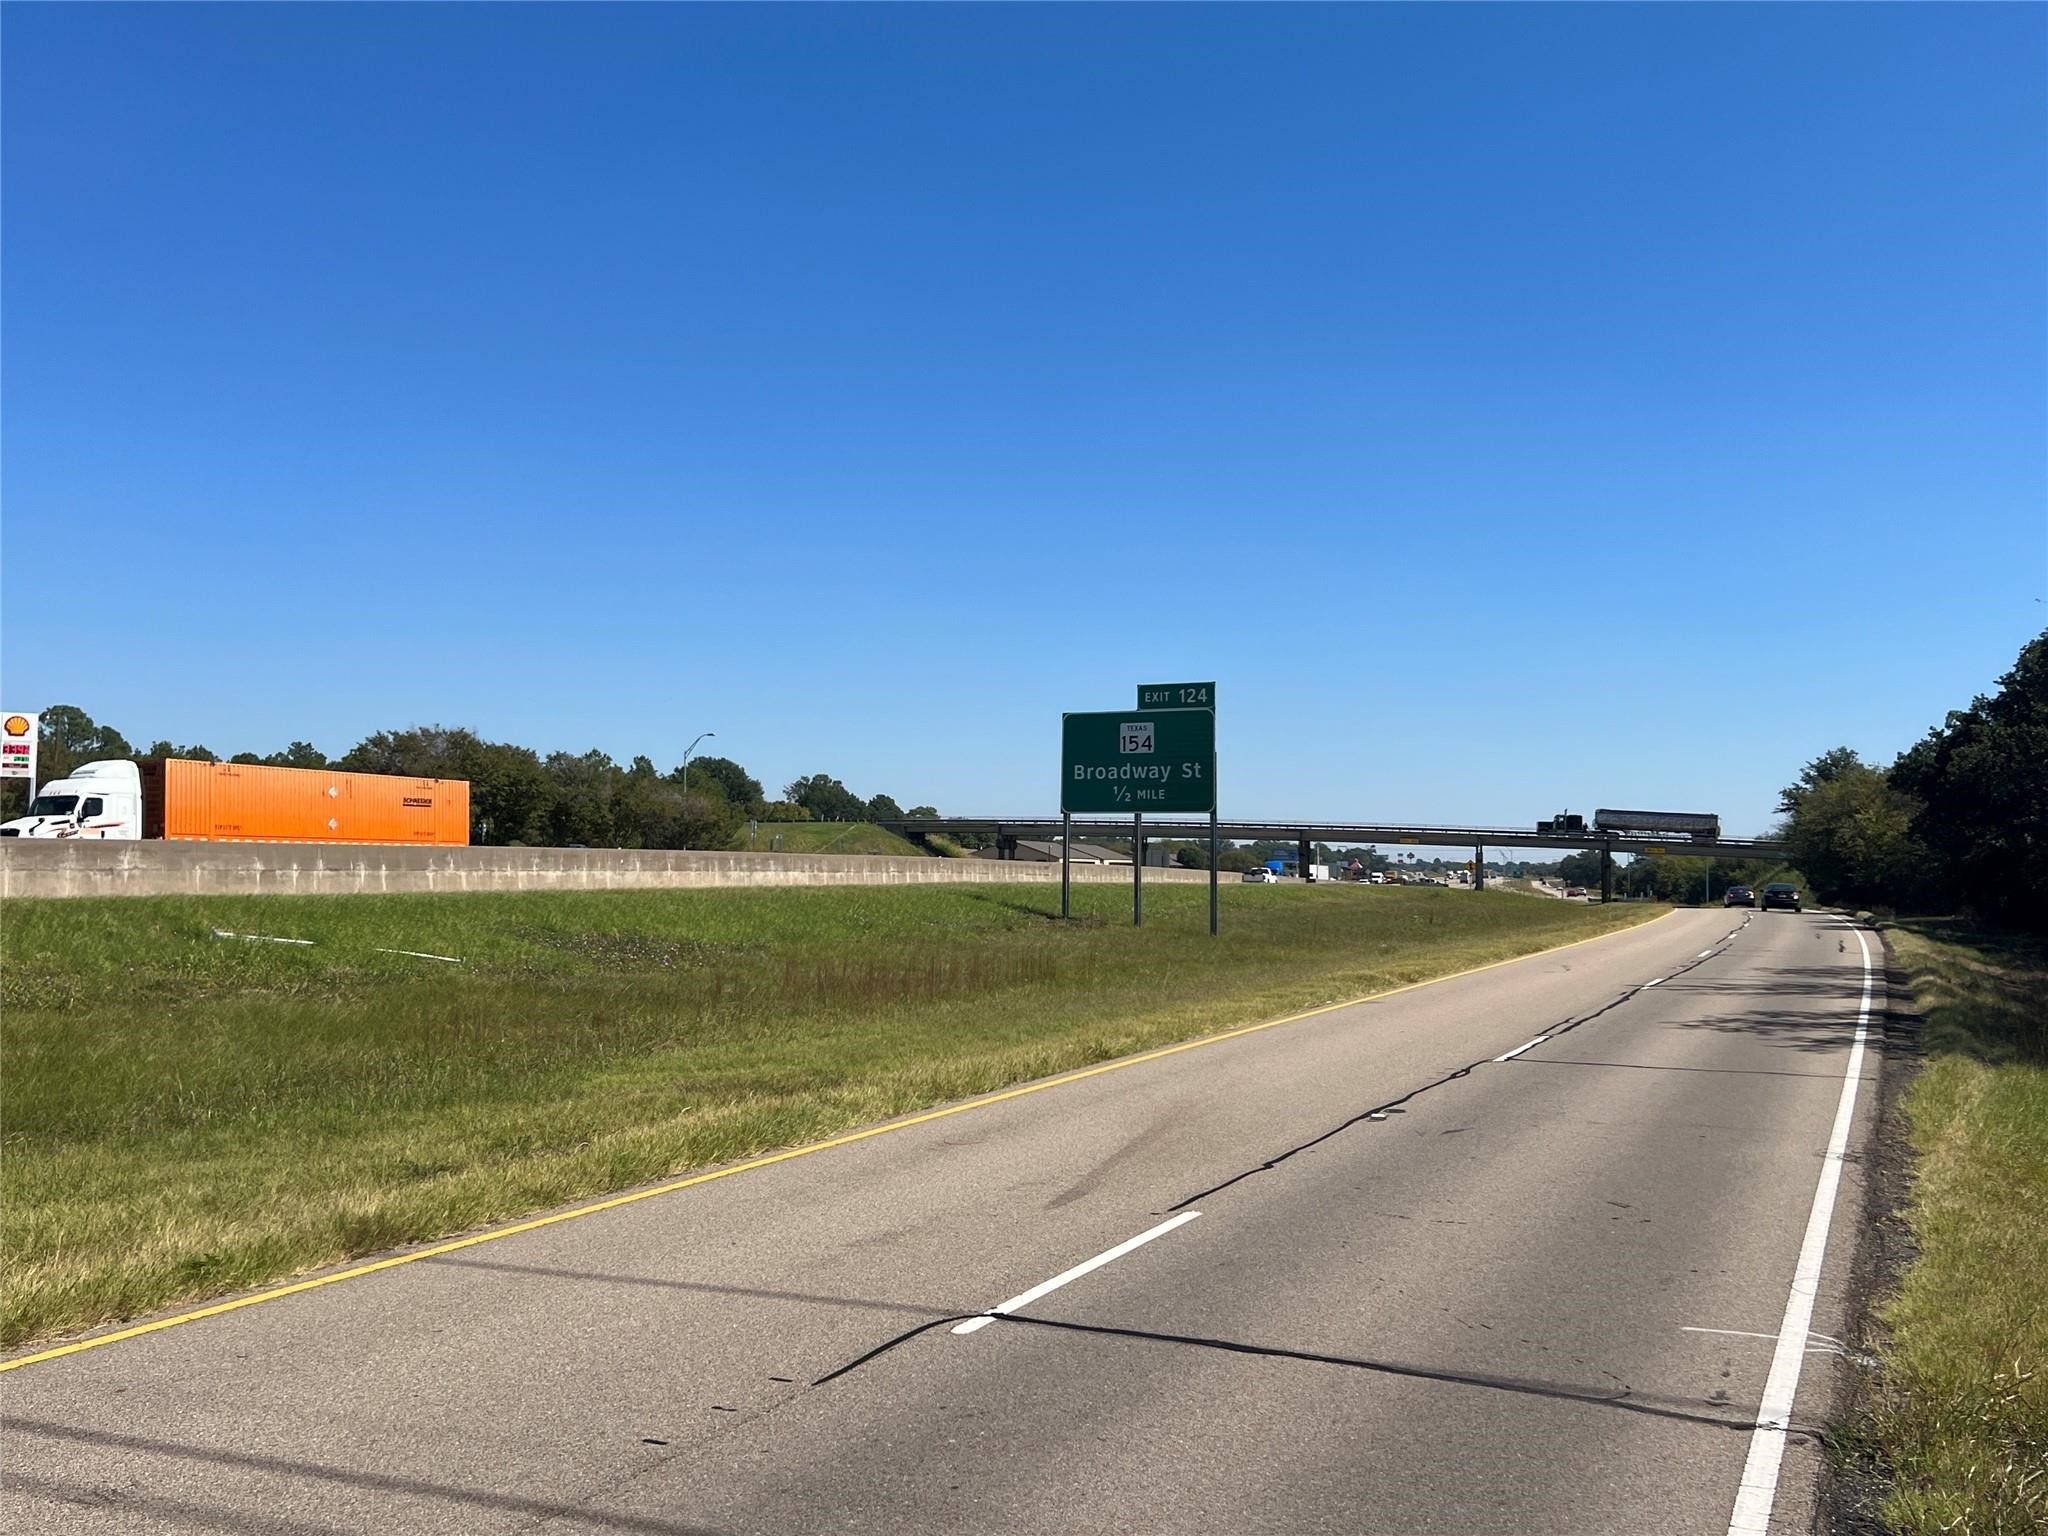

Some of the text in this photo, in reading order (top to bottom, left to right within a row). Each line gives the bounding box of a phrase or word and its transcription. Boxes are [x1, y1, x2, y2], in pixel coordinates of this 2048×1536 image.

[1144, 688, 1208, 703] EXIT 124
[1121, 735, 1153, 752] 154
[1074, 762, 1202, 783] Broadway St
[1137, 789, 1166, 800] MILE
